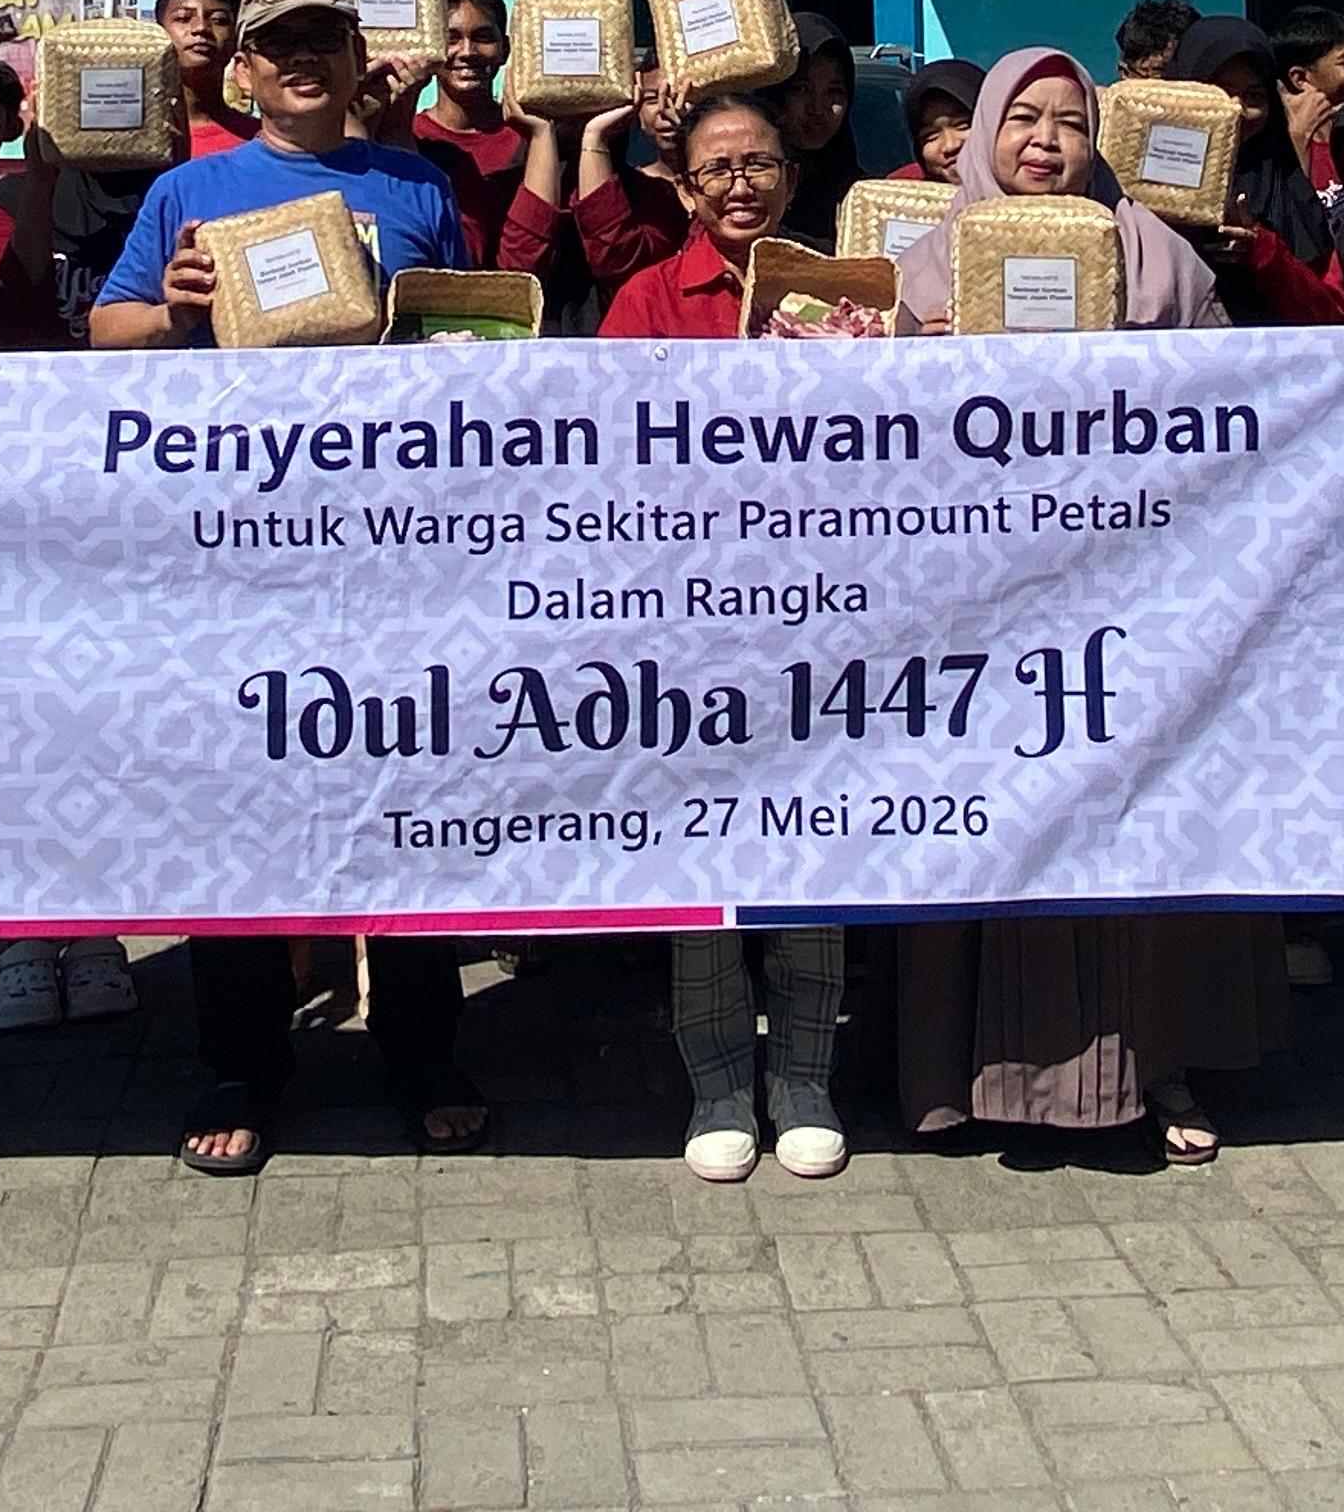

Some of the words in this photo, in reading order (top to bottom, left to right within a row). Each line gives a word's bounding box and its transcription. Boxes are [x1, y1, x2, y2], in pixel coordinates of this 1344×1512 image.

[104, 400, 599, 492] Penyerahan
[636, 399, 920, 465] Hewan
[952, 390, 1260, 467] Qurban
[193, 506, 346, 549] Untuk
[363, 506, 526, 555] Warga
[545, 500, 720, 543] Sekitar
[739, 496, 1012, 540] Paramount
[1031, 490, 1172, 533] Petals
[508, 578, 664, 621] Dalam
[686, 573, 868, 626] Rangka
[237, 665, 451, 761] Idul
[472, 658, 755, 760] Adha
[780, 652, 990, 742] 1447
[1013, 625, 1128, 759] H
[383, 808, 663, 857] Tangerang,
[683, 797, 740, 838] 27
[761, 795, 849, 837] Mei
[870, 795, 989, 836] 2026
